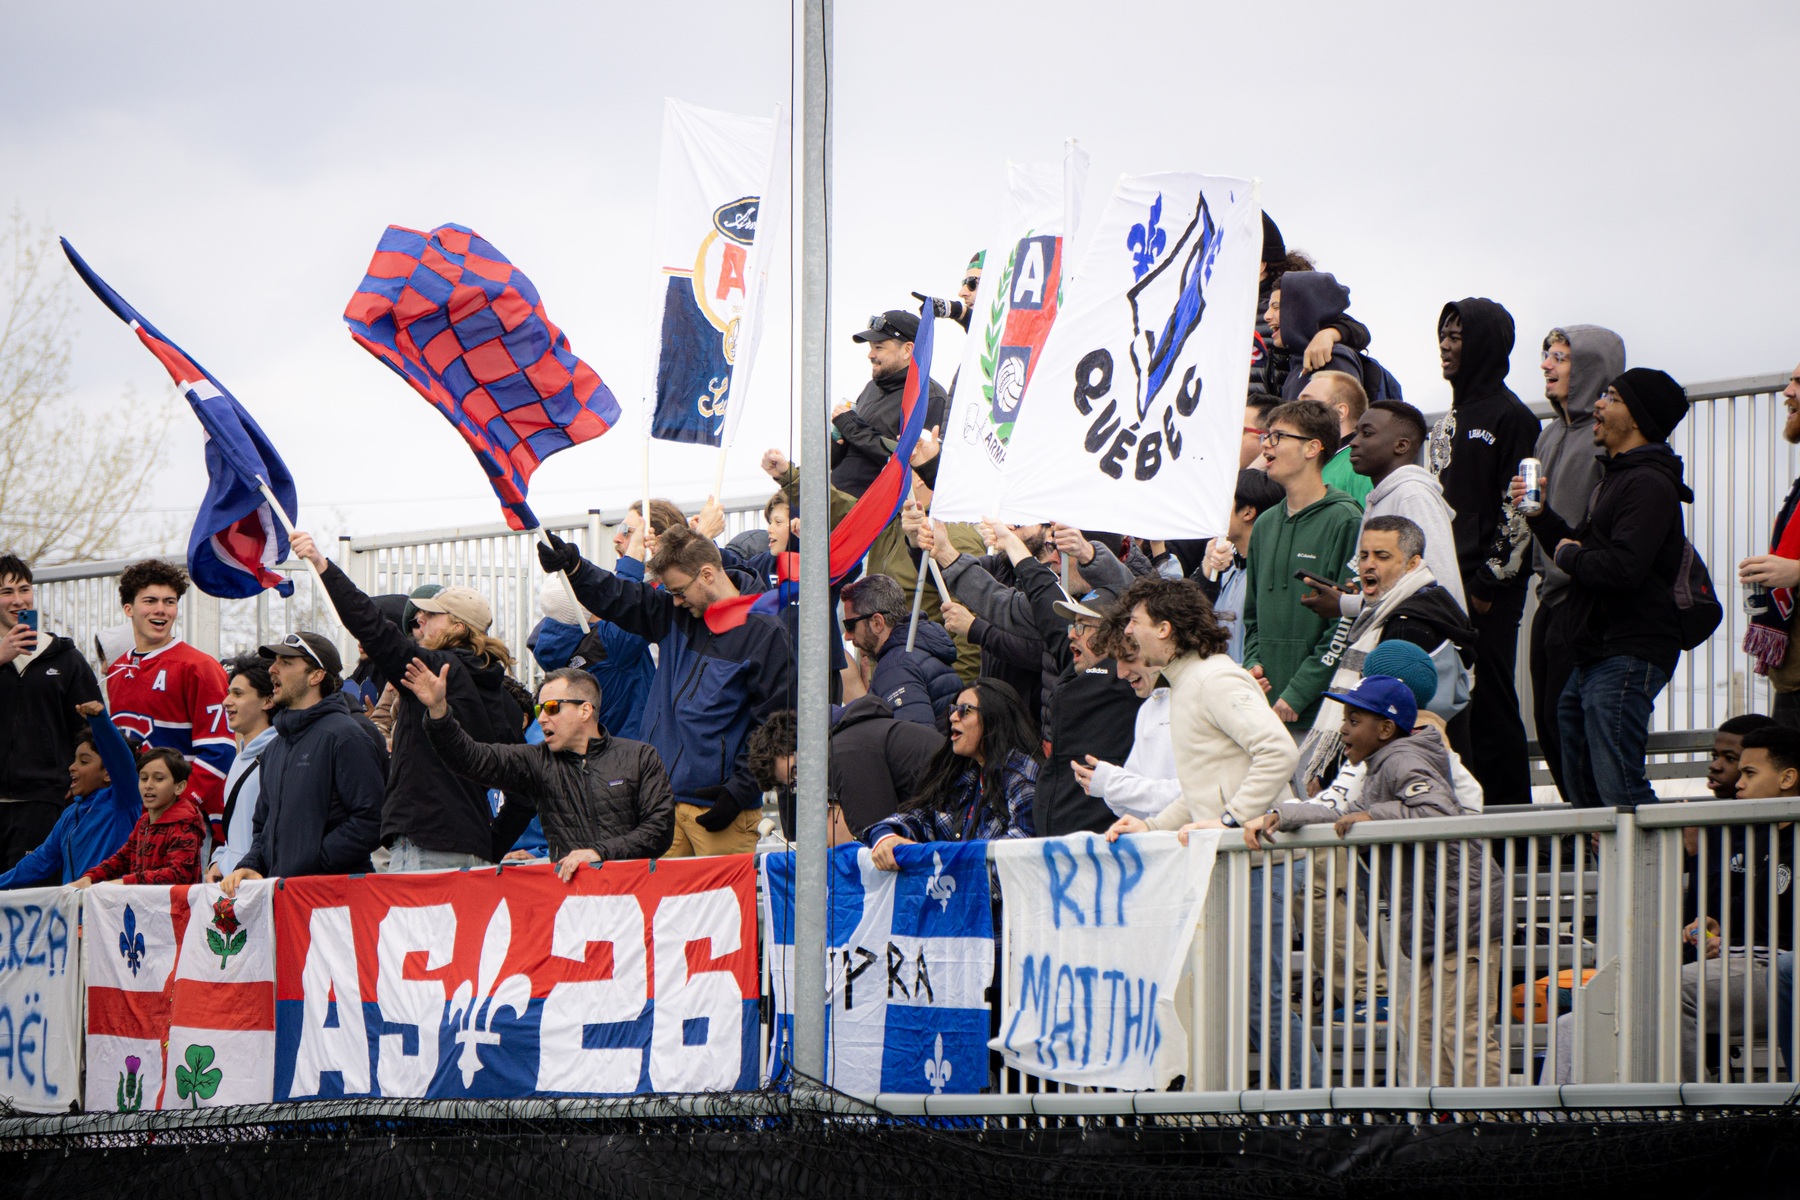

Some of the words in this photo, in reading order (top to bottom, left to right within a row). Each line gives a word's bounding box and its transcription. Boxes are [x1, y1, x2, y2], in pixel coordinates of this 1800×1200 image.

[1013, 241, 1045, 303] A
[1074, 348, 1202, 481] QUÉBEC
[151, 669, 167, 692] A
[1085, 667, 1109, 675] adidas
[1042, 834, 1144, 931] RIP
[0, 904, 68, 976] RZA
[289, 902, 458, 1098] AS
[536, 886, 743, 1093] 26
[829, 941, 934, 1011] PRA
